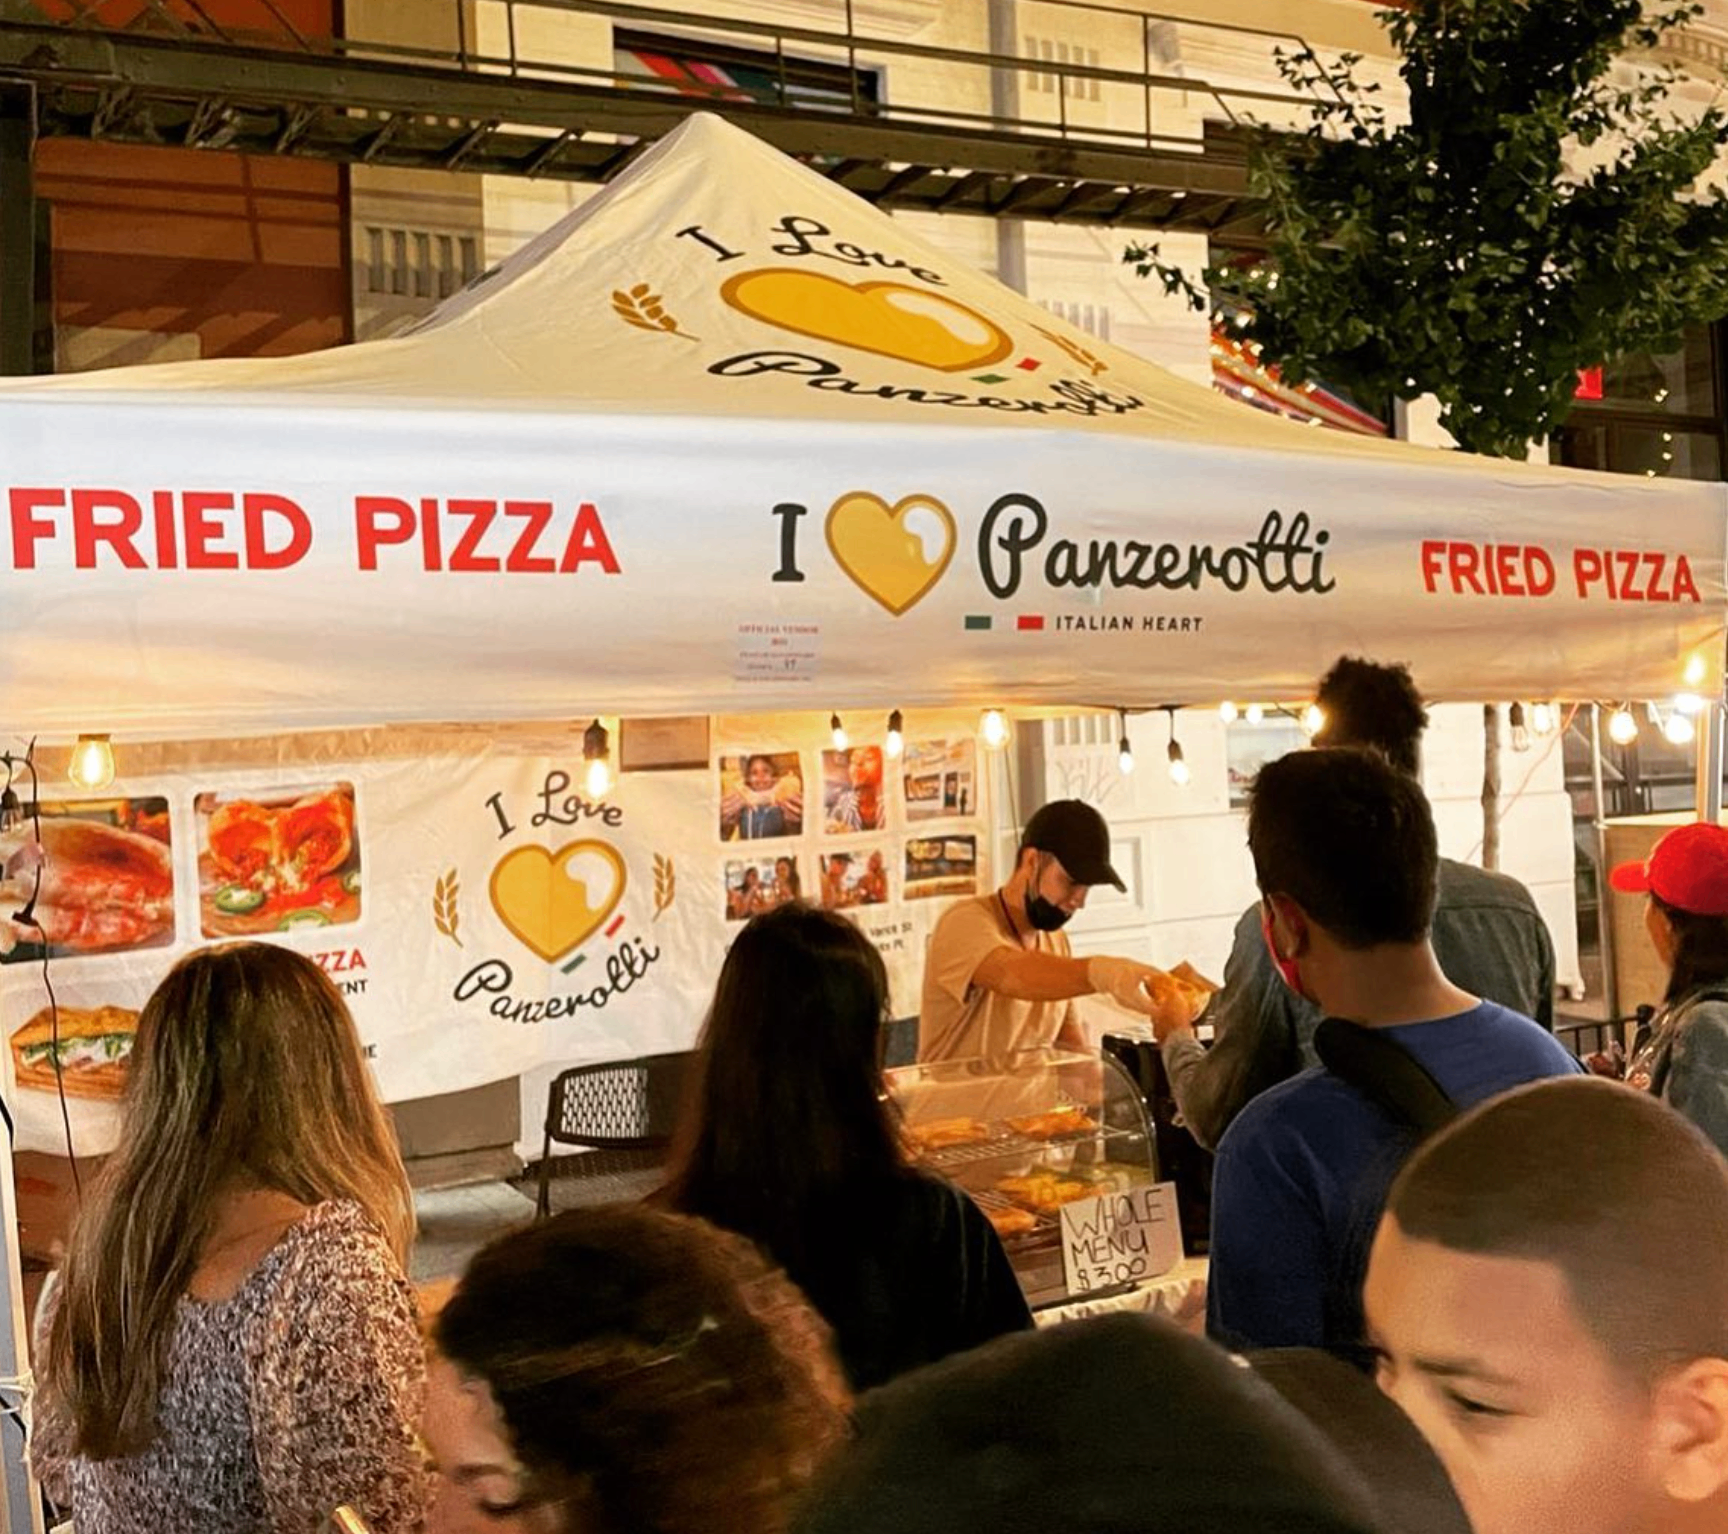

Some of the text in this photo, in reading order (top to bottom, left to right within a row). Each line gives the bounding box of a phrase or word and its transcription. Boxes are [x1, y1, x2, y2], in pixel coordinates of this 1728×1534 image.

[676, 216, 947, 285] I Love
[707, 351, 1144, 416] Panzerotti
[9, 488, 622, 574] FRIED PIZZA
[772, 492, 1336, 599] I Panzerotti
[1422, 540, 1701, 602] FRIED PIZZA
[1056, 615, 1203, 632] ITALIAN HEART
[485, 770, 622, 840] I Love
[453, 936, 660, 1024] Panzerotti
[1063, 1188, 1165, 1239] WHOLE
[1071, 1228, 1149, 1268] MENU
